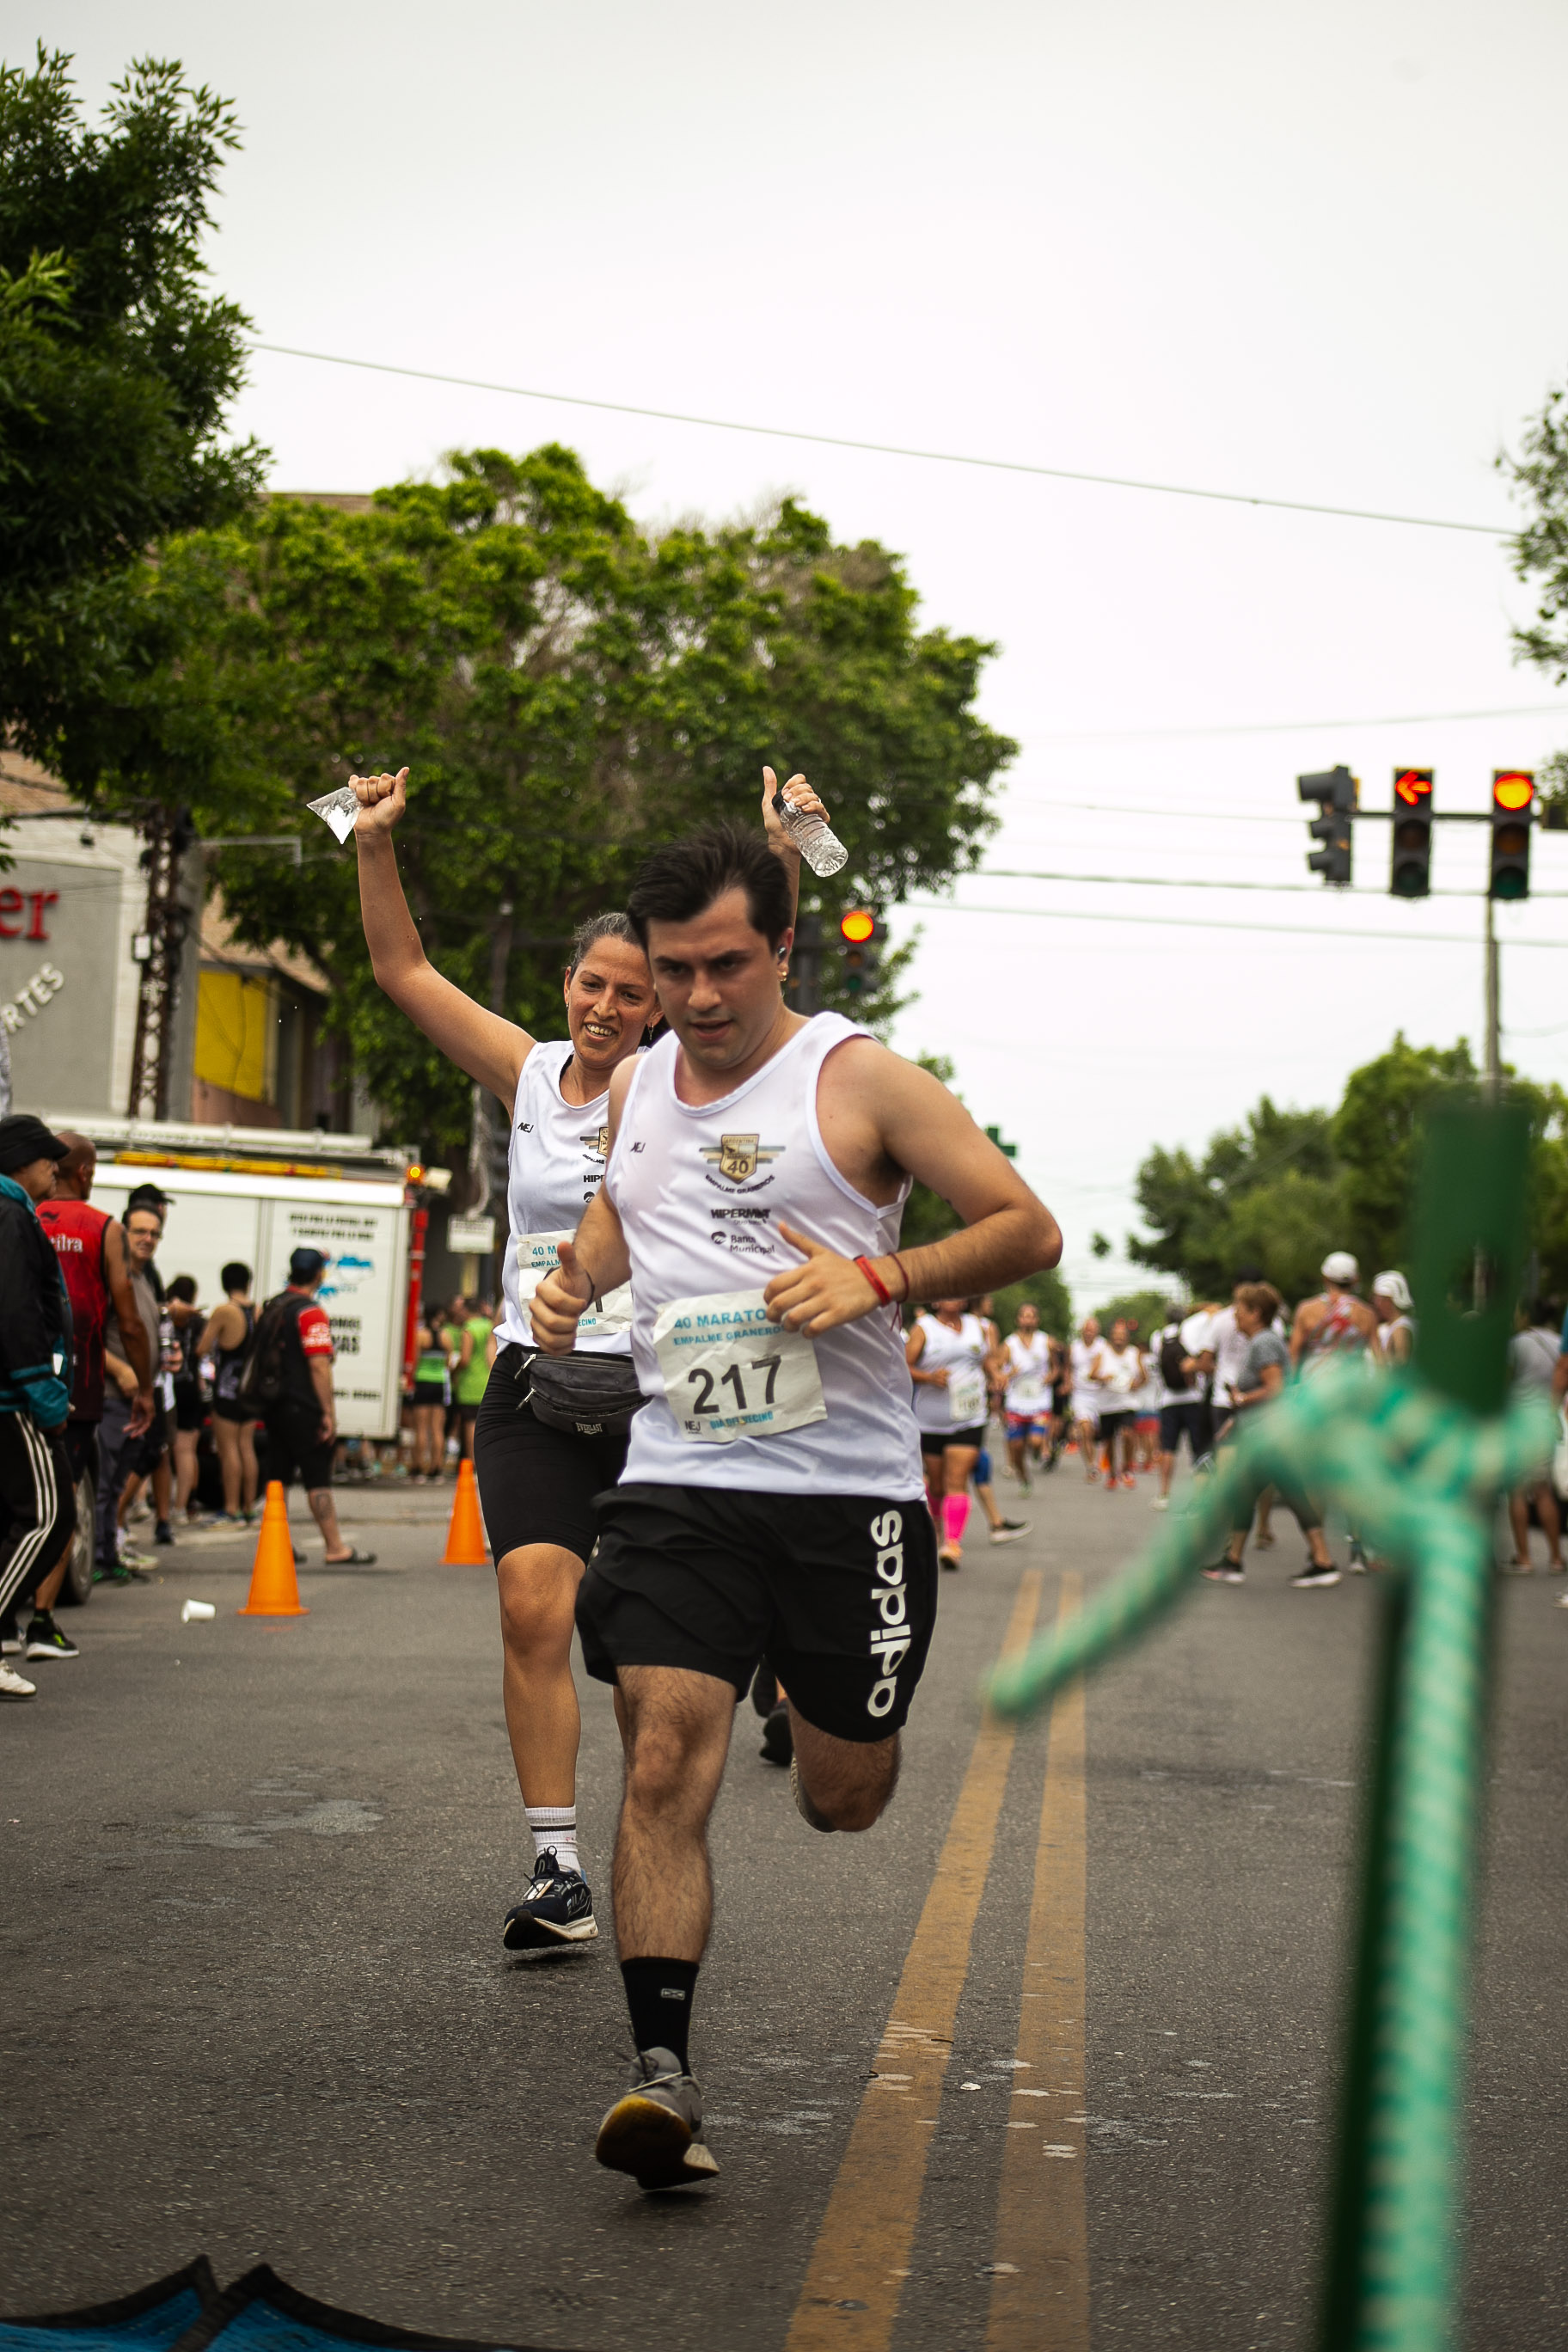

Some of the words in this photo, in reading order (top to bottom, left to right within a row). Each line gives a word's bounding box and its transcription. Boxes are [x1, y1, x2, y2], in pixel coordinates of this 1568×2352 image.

[0, 962, 64, 1034] RTES
[726, 1160, 750, 1174] 40
[705, 1173, 735, 1193] EMPALME
[532, 1246, 544, 1256] 40
[578, 1318, 597, 1326] ECINO
[674, 1317, 691, 1329] 40
[697, 1308, 767, 1328] MARATO
[674, 1332, 723, 1346] EMPALME
[688, 1355, 782, 1415] 217
[741, 1411, 773, 1424] VECINO
[575, 1422, 603, 1432] EVERLAST
[867, 1510, 911, 1718] adidas
